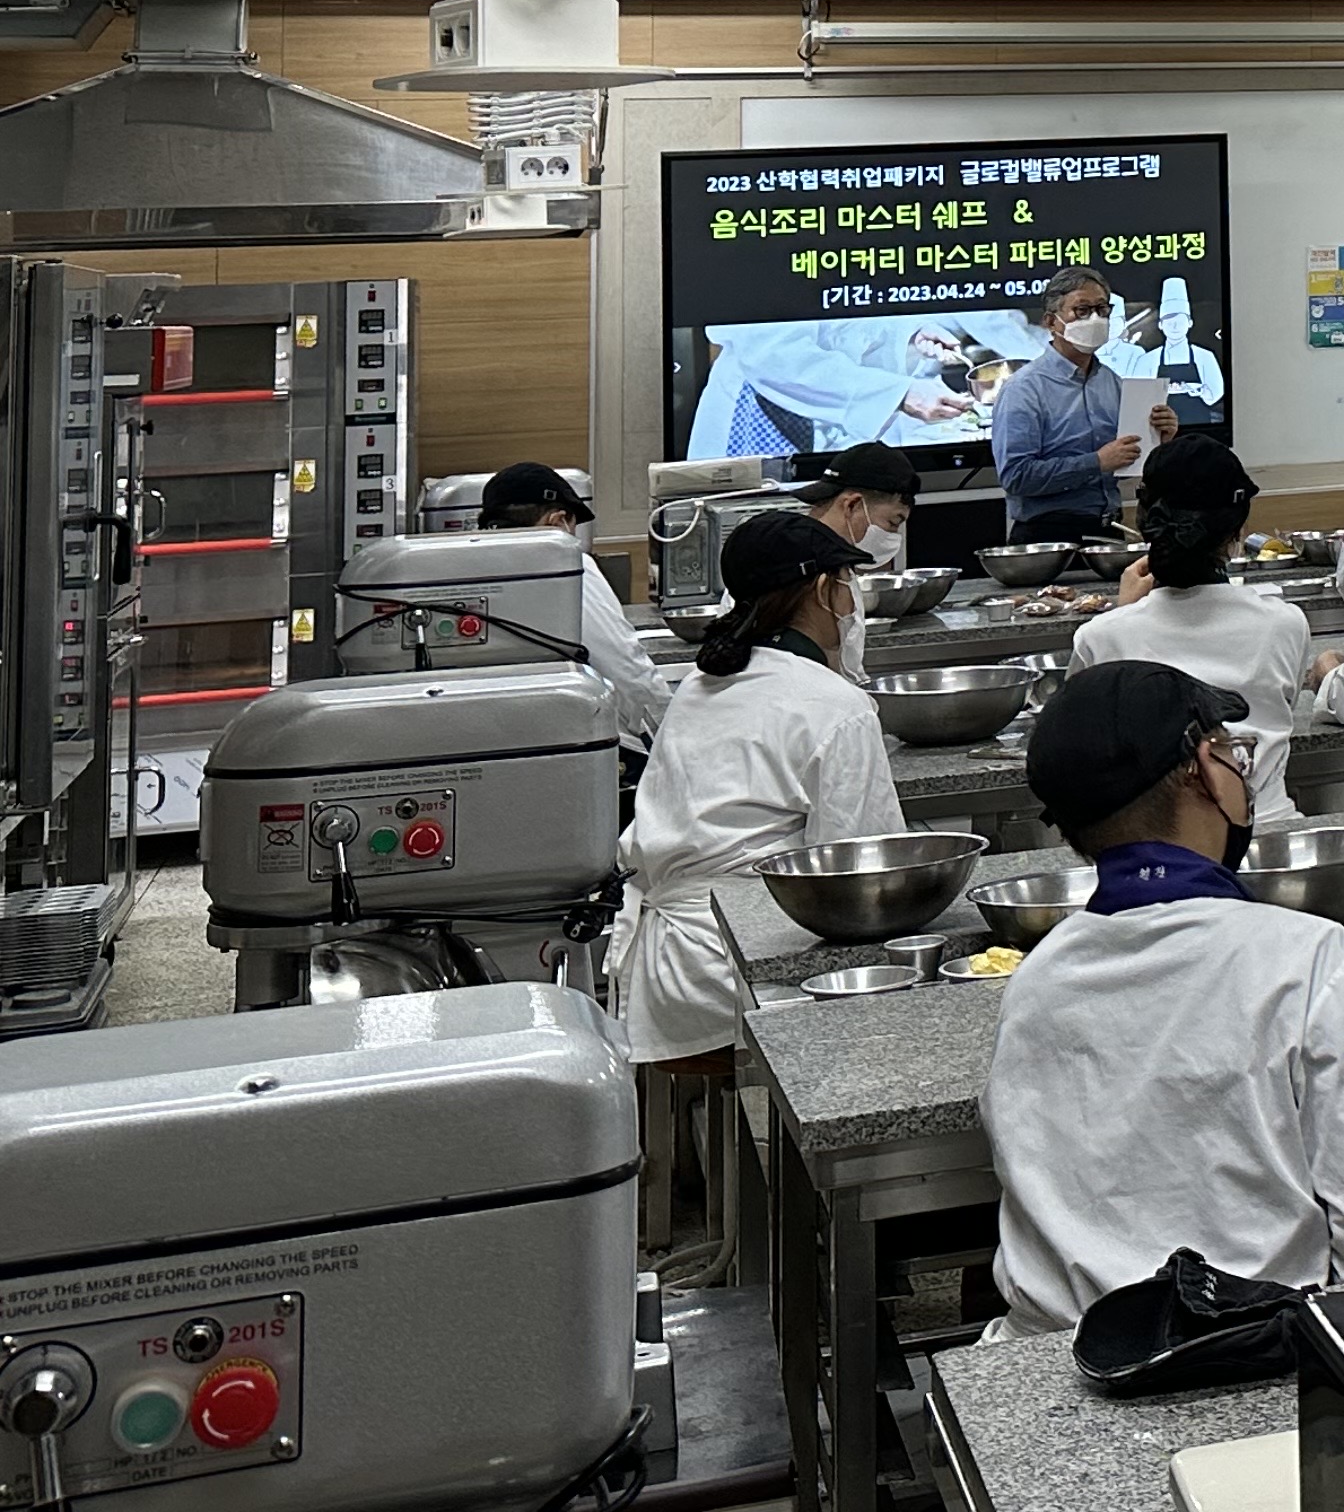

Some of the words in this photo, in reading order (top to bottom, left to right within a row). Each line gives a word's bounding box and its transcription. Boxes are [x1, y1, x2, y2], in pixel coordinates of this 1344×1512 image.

[706, 175, 751, 193] 2023
[756, 164, 945, 191] 산학협력취업패키지
[960, 154, 1161, 186] 글로컬밸류업프로그램
[710, 206, 826, 239] 음식조리
[837, 201, 921, 234] 마스터
[932, 200, 988, 230] 쉐프
[1013, 199, 1034, 224] &
[791, 245, 905, 280] 베이커리
[916, 241, 998, 273] 마스터
[1009, 237, 1091, 268] 파티쉐
[1101, 231, 1206, 265] 양성과정
[822, 284, 871, 309] [기간
[888, 282, 986, 303] 2023.04.24
[388, 331, 394, 342] 1
[386, 478, 394, 489] 3
[378, 806, 393, 815] TS
[420, 800, 447, 812] 201S
[7, 1299, 68, 1319] UNPLUG
[71, 1290, 130, 1309] BEFORE
[134, 1279, 206, 1300] CLEANING
[210, 1276, 231, 1289] OR
[234, 1265, 310, 1286] REMOVING
[313, 1258, 359, 1274] PARTS
[8, 1287, 48, 1303] STOP
[54, 1282, 82, 1296] THE
[86, 1275, 132, 1292] MIXER
[136, 1266, 196, 1284] BEFORE
[200, 1255, 275, 1276] CHANGING
[280, 1251, 306, 1264] THE
[311, 1244, 359, 1260] SPEED
[137, 1337, 168, 1357] TS
[228, 1318, 286, 1344] 201S
[132, 1466, 167, 1482] DATE
